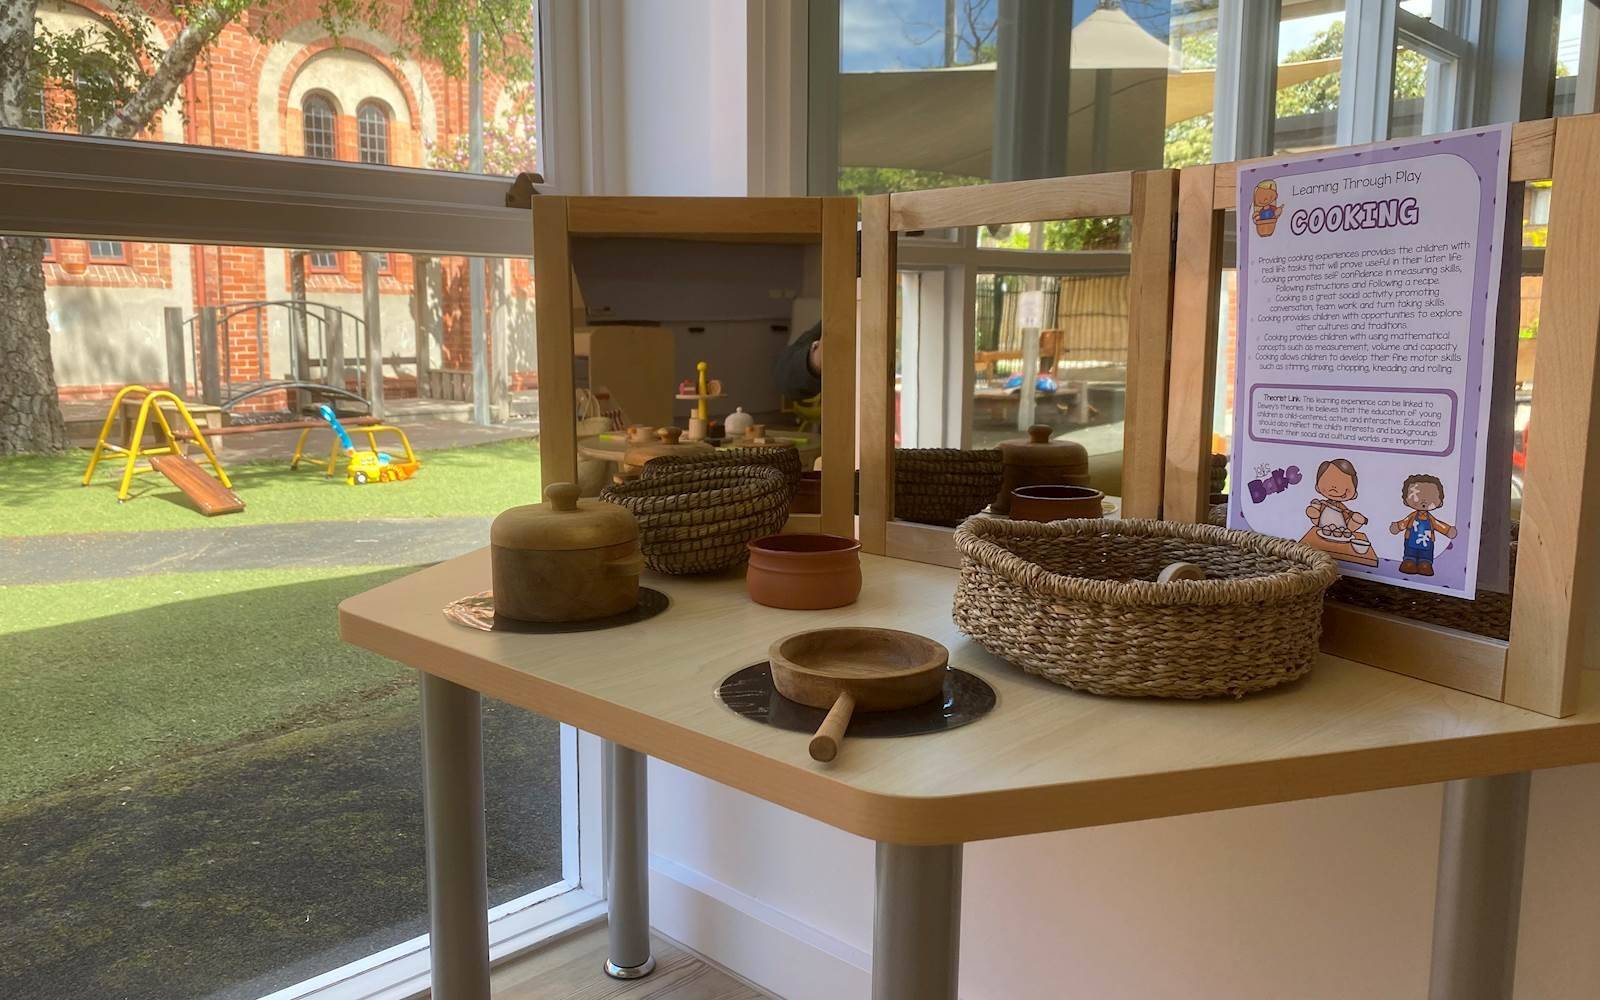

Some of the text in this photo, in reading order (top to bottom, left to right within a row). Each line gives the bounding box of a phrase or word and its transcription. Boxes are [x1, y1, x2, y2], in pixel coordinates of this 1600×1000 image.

[1292, 170, 1422, 196] Learning Through Play
[1290, 197, 1419, 236] COOKING
[1288, 254, 1313, 262] cooking
[1315, 250, 1360, 260] experiences
[1361, 248, 1396, 258] provides
[1399, 246, 1413, 254] the
[1416, 244, 1448, 253] children
[1451, 241, 1470, 250] with
[1288, 264, 1306, 272] tasks
[1308, 262, 1325, 270] that
[1340, 261, 1362, 269] prove
[1365, 258, 1390, 267] useful
[1402, 256, 1422, 264] their
[1425, 255, 1446, 263] later
[1262, 276, 1286, 284] Cooking
[1287, 273, 1322, 282] promotes
[1324, 271, 1339, 279] self
[1340, 269, 1383, 279] confidence
[1394, 267, 1438, 276] measuring
[1440, 264, 1462, 273] skills,
[1306, 282, 1350, 291] instructions
[1352, 280, 1366, 289] and
[1369, 278, 1402, 288] following
[1276, 294, 1300, 303] Cooking
[1316, 293, 1336, 302] great
[1339, 291, 1360, 299] social
[1362, 290, 1393, 299] activity
[1396, 288, 1440, 297] promoting
[1338, 301, 1357, 310] work
[1377, 300, 1394, 308] turn
[1398, 299, 1422, 309] taking
[1425, 298, 1444, 306] skills
[1258, 314, 1281, 323] Cooking
[1282, 314, 1310, 322] provides
[1312, 313, 1339, 321] children
[1342, 312, 1359, 320] with
[1361, 311, 1415, 320] opportunities
[1430, 309, 1462, 319] explore
[1296, 323, 1316, 331] other
[1318, 322, 1349, 331] cultures
[1351, 322, 1365, 330] and
[1264, 333, 1288, 343] Cooking
[1289, 333, 1317, 342] provides
[1320, 333, 1347, 341] children
[1349, 332, 1366, 340] with
[1368, 333, 1388, 342] using
[1257, 344, 1286, 352] concepts
[1287, 343, 1303, 351] such
[1315, 343, 1369, 352] measurement,
